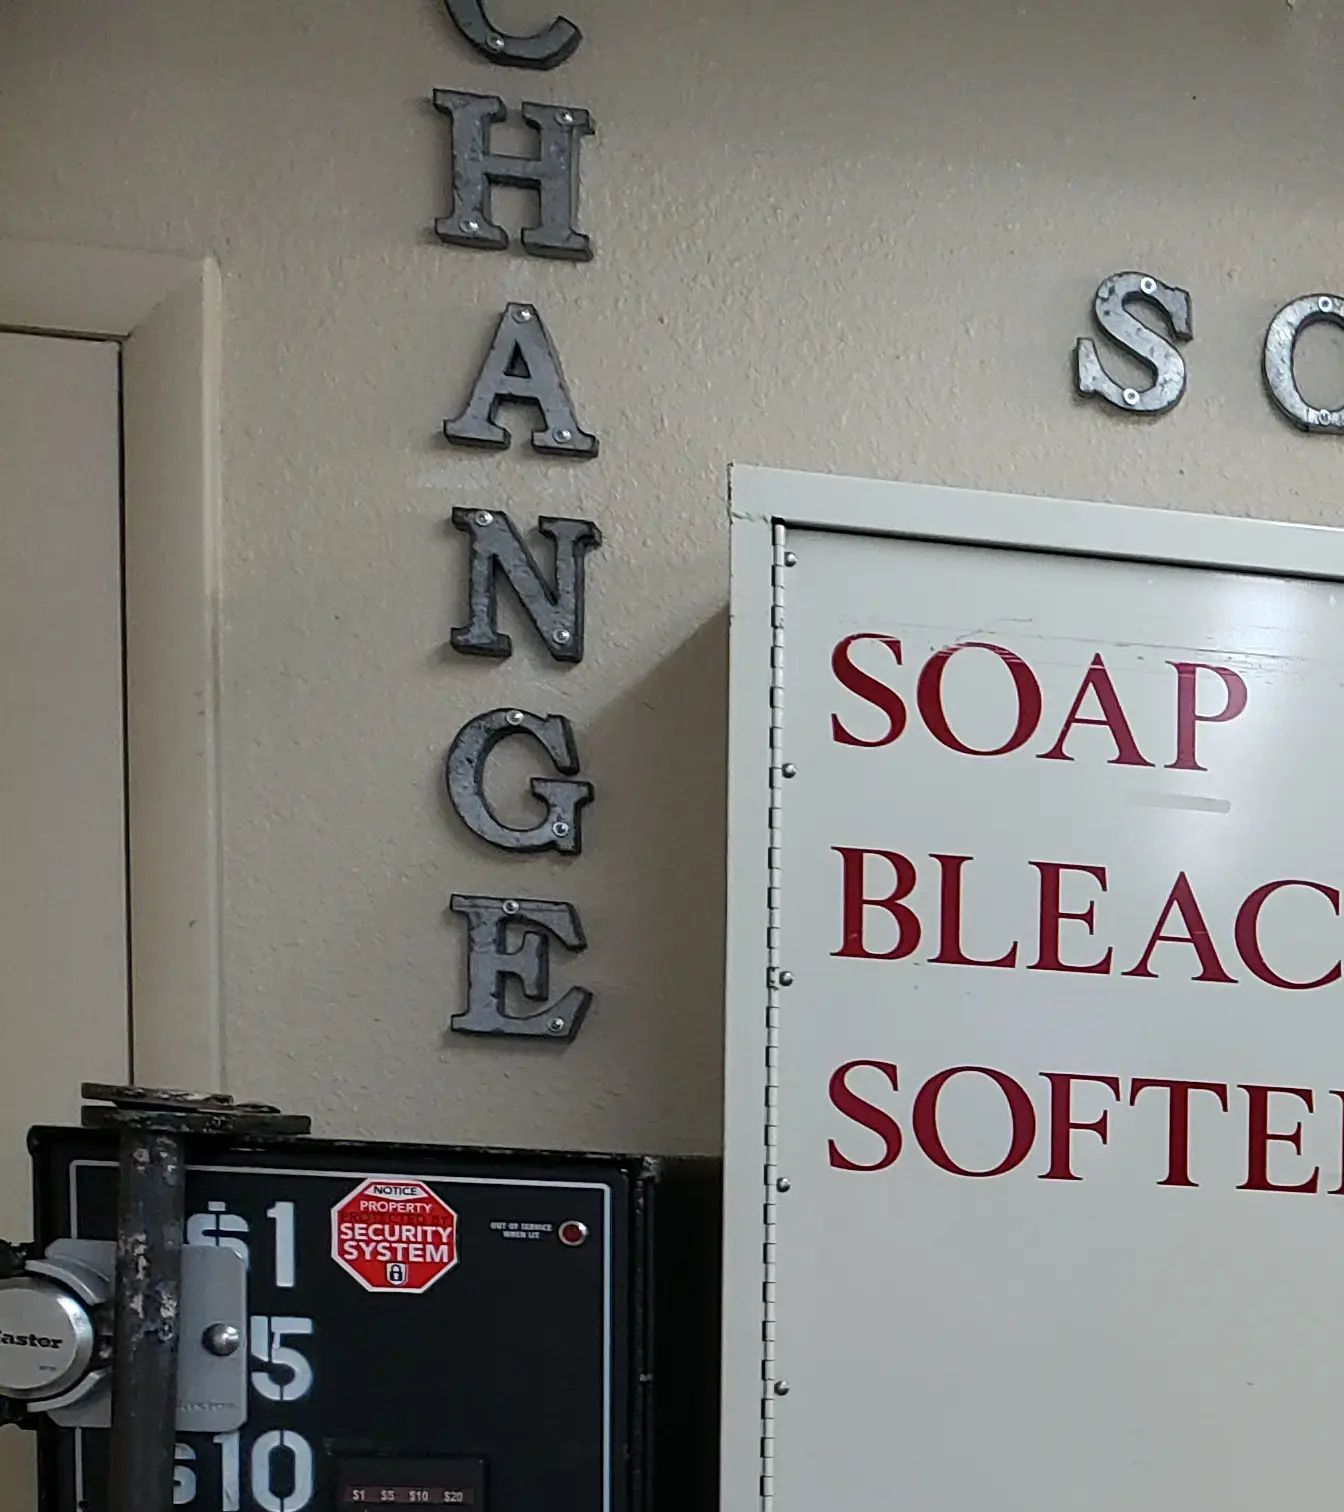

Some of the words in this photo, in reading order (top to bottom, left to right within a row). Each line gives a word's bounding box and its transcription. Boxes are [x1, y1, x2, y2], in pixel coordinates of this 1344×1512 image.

[829, 631, 1249, 772] SOAP
[374, 1185, 417, 1196] NOTICE
[360, 1200, 432, 1213] PROPERTY
[340, 1223, 452, 1243] SECURITY
[343, 1241, 449, 1263] SYSTEM
[0, 1329, 63, 1351] aster
[250, 1315, 314, 1401] 5
[352, 1488, 366, 1501] $1
[409, 1490, 429, 1502] $10
[443, 1491, 464, 1503] $20
